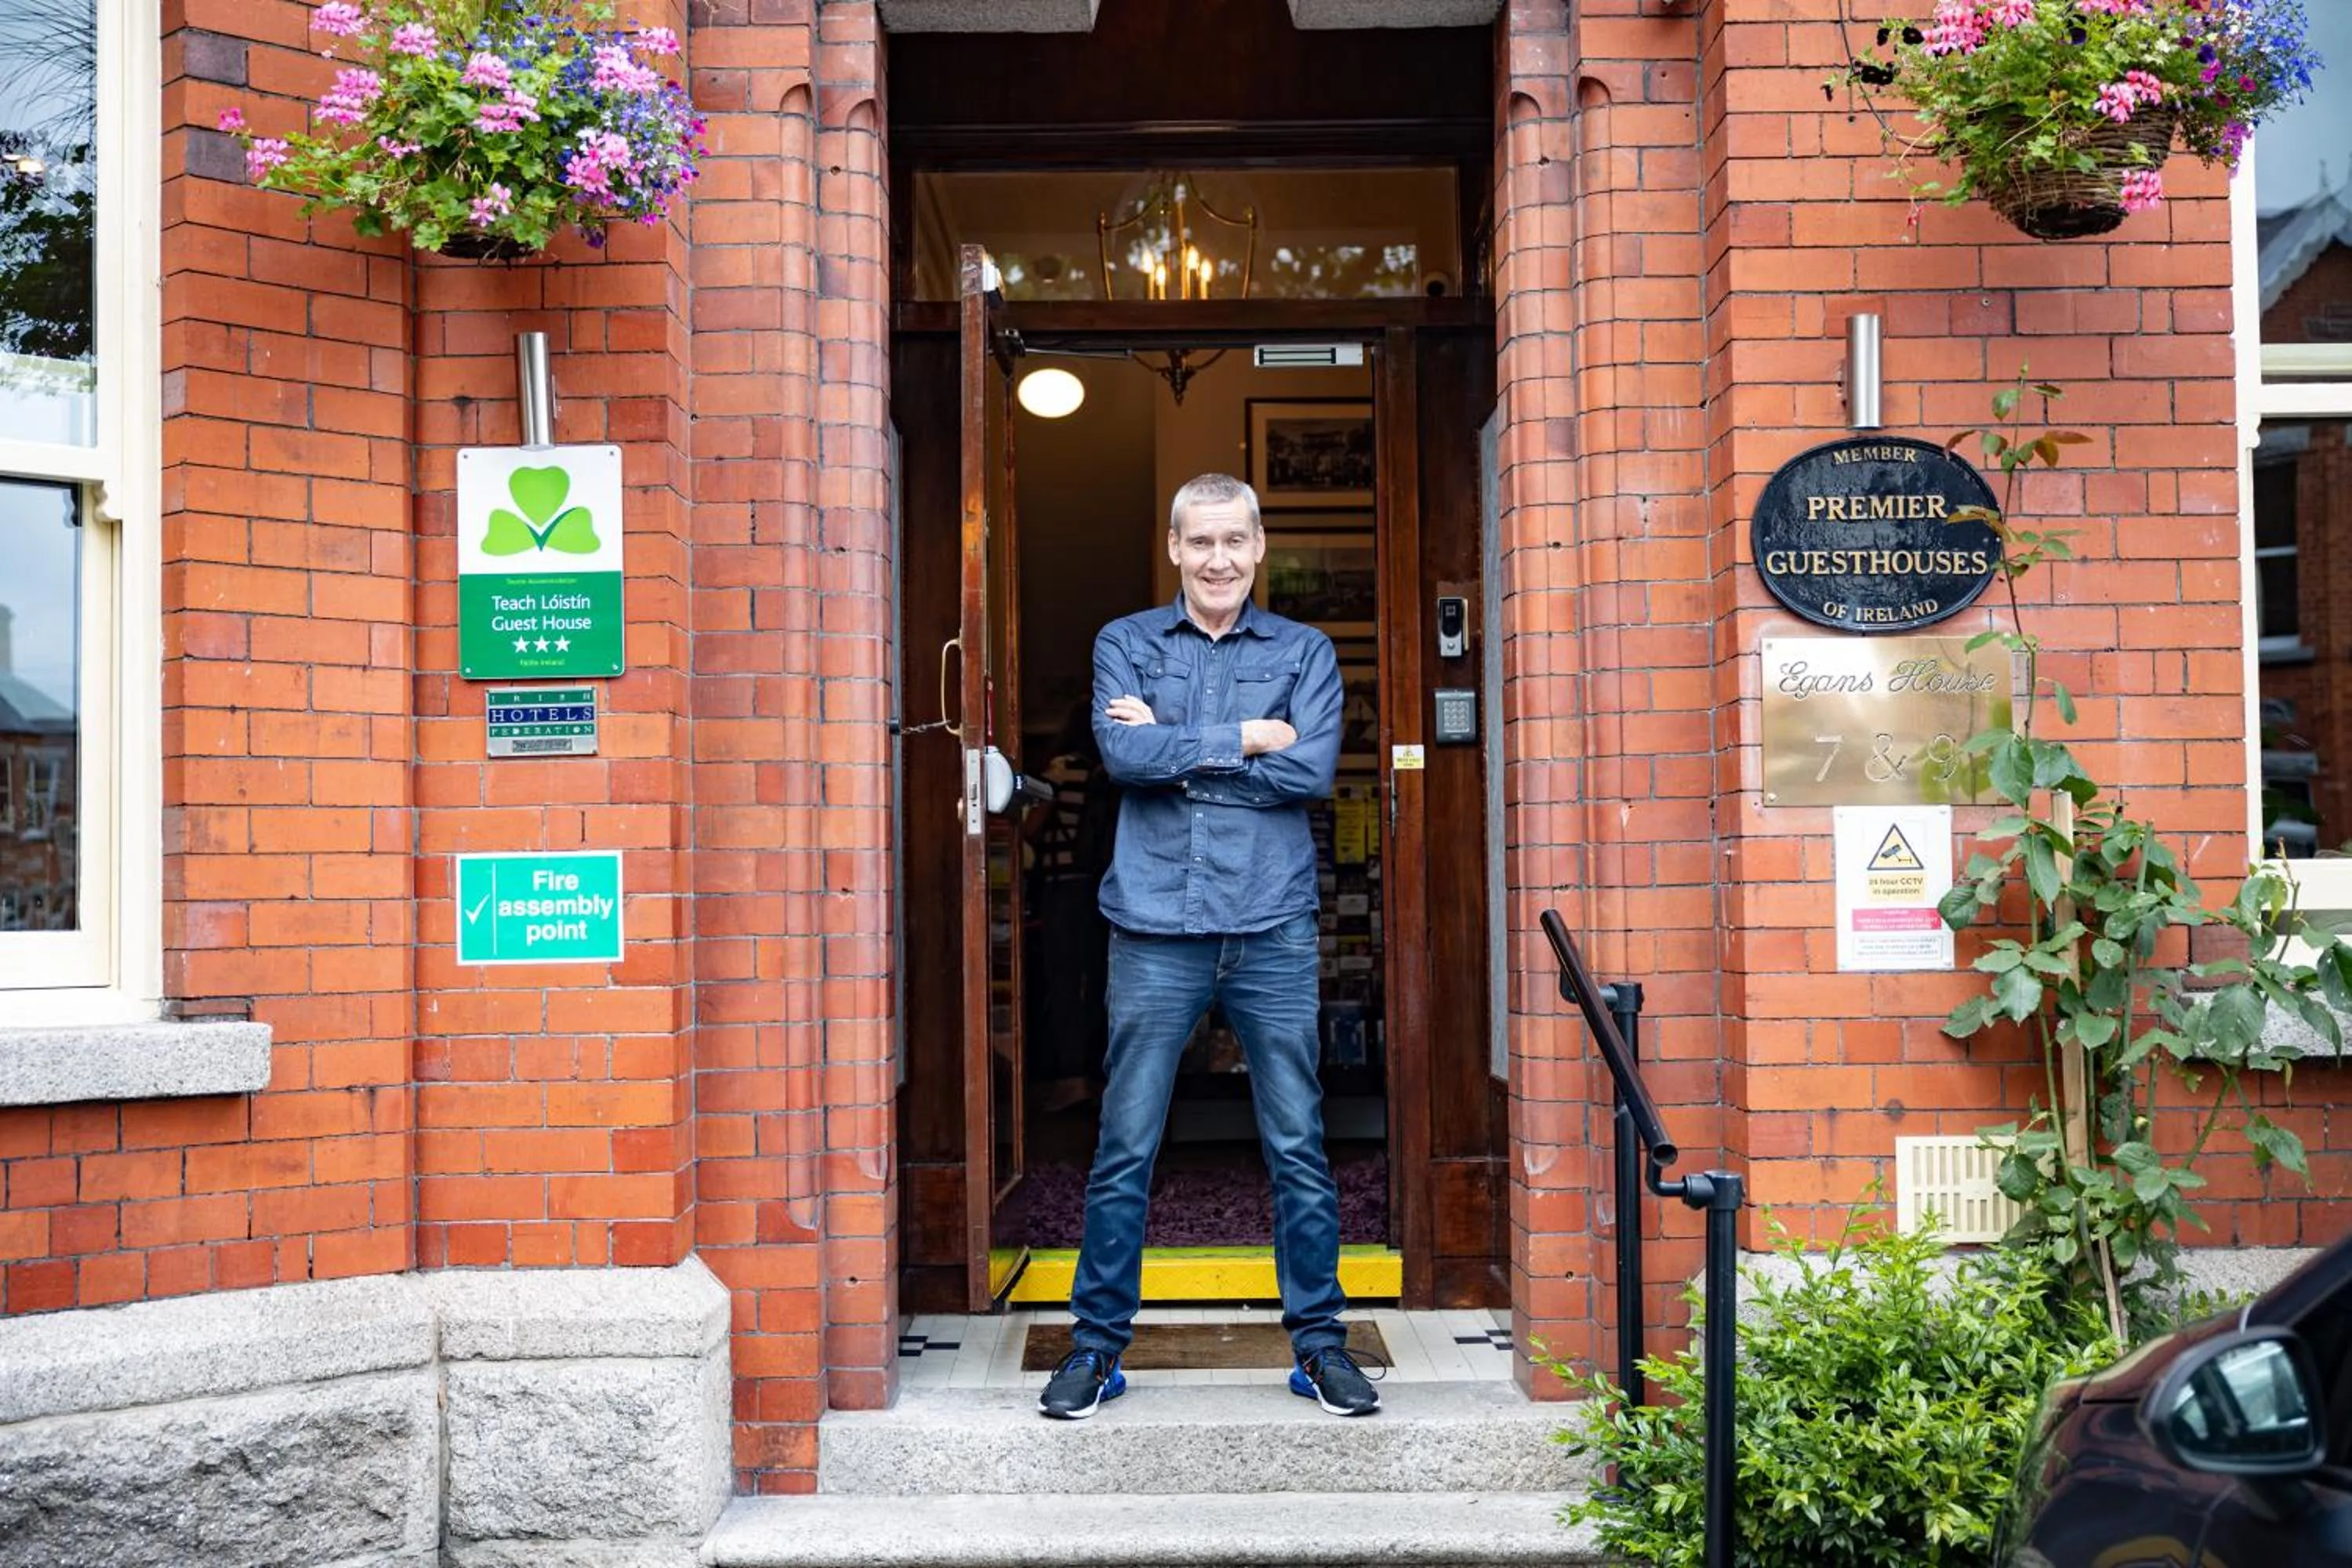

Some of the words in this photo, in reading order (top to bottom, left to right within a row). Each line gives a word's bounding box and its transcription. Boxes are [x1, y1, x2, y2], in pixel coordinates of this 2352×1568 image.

[1832, 445, 1918, 466] MEMBER
[1806, 494, 1948, 521] PREMIER
[1766, 550, 1988, 576] GUESTHOUSES
[492, 594, 536, 611] Teach
[542, 593, 590, 610] Lóistín
[1823, 601, 1847, 619] OF
[1855, 598, 1939, 622] IRELAND
[492, 615, 538, 632] Guest
[543, 614, 593, 630] House
[1779, 661, 1874, 700] Egans
[1888, 659, 1995, 693] House
[492, 706, 593, 722] HOTELS
[1814, 734, 1844, 782] 7
[1864, 732, 1907, 782] &
[1926, 733, 1958, 782] 9
[532, 870, 579, 891] Fire
[498, 894, 614, 920] assembly
[526, 920, 588, 947] point
